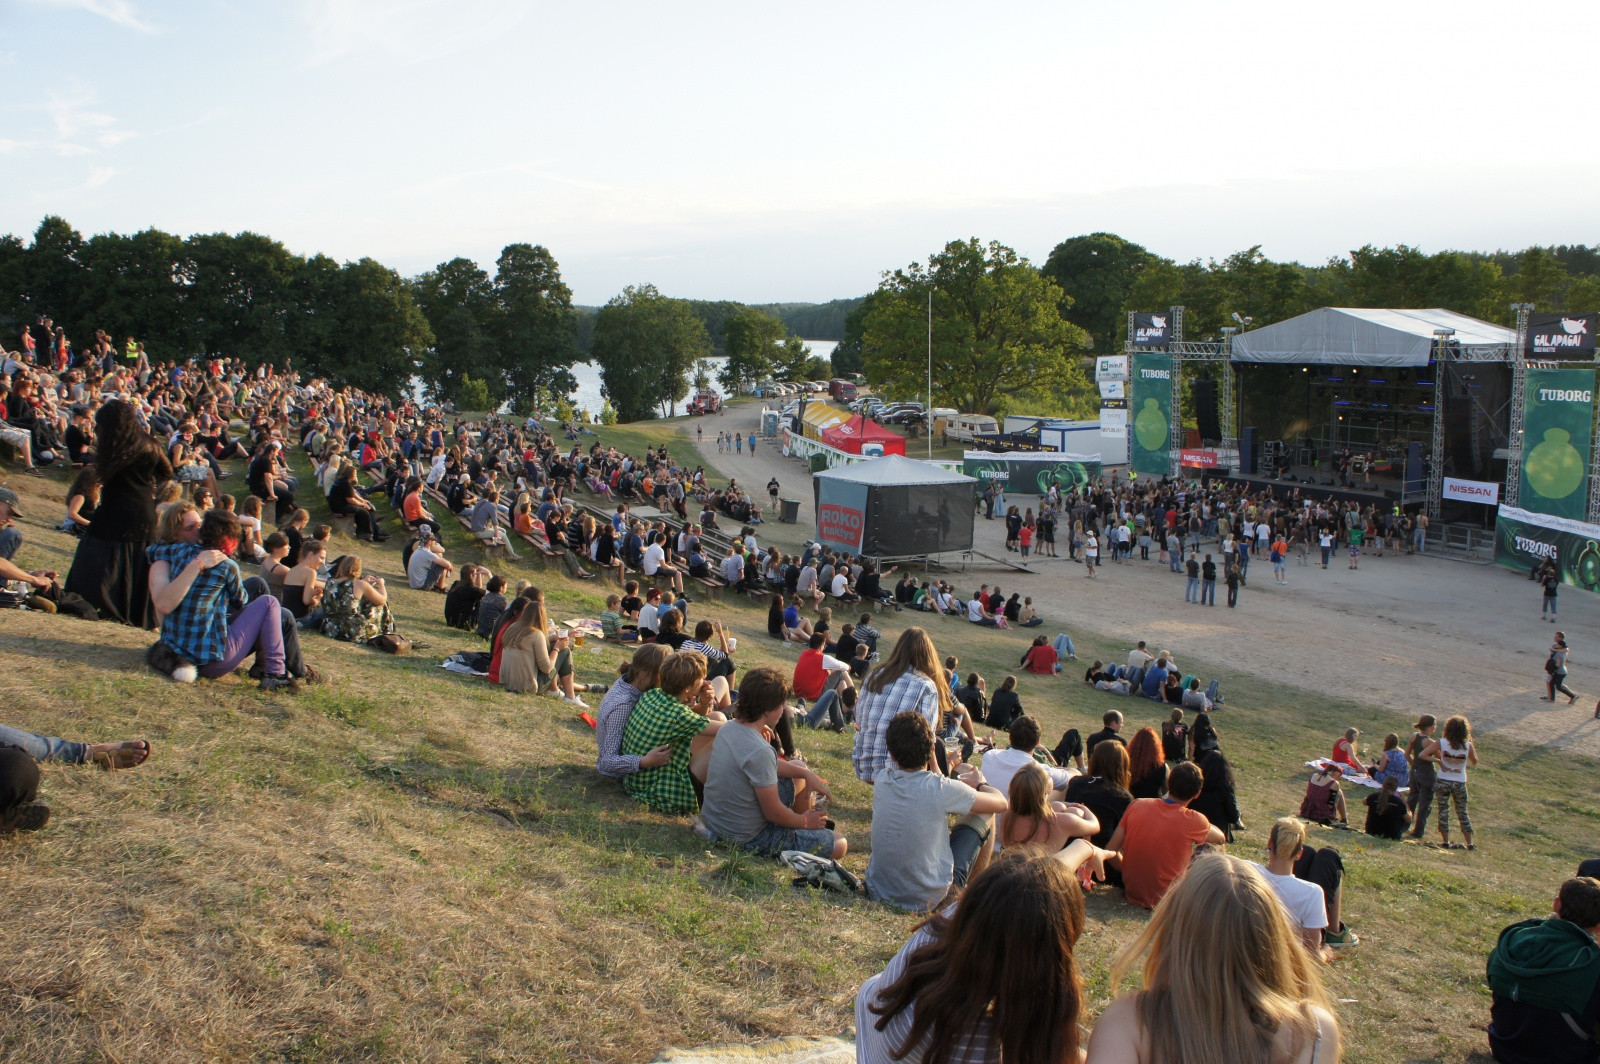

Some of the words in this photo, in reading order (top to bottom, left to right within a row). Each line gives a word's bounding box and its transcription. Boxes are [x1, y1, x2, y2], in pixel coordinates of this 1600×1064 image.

[1534, 334, 1582, 347] GALAPAGAI
[1141, 369, 1170, 379] TUBORG
[1540, 388, 1591, 403] TUBORG
[1184, 455, 1212, 464] NISSAN
[980, 471, 1009, 479] TUBORG
[1449, 484, 1491, 497] NISSAN
[821, 508, 861, 529] ROKO
[823, 526, 856, 541] naktys
[1515, 536, 1558, 559] TUBORG
